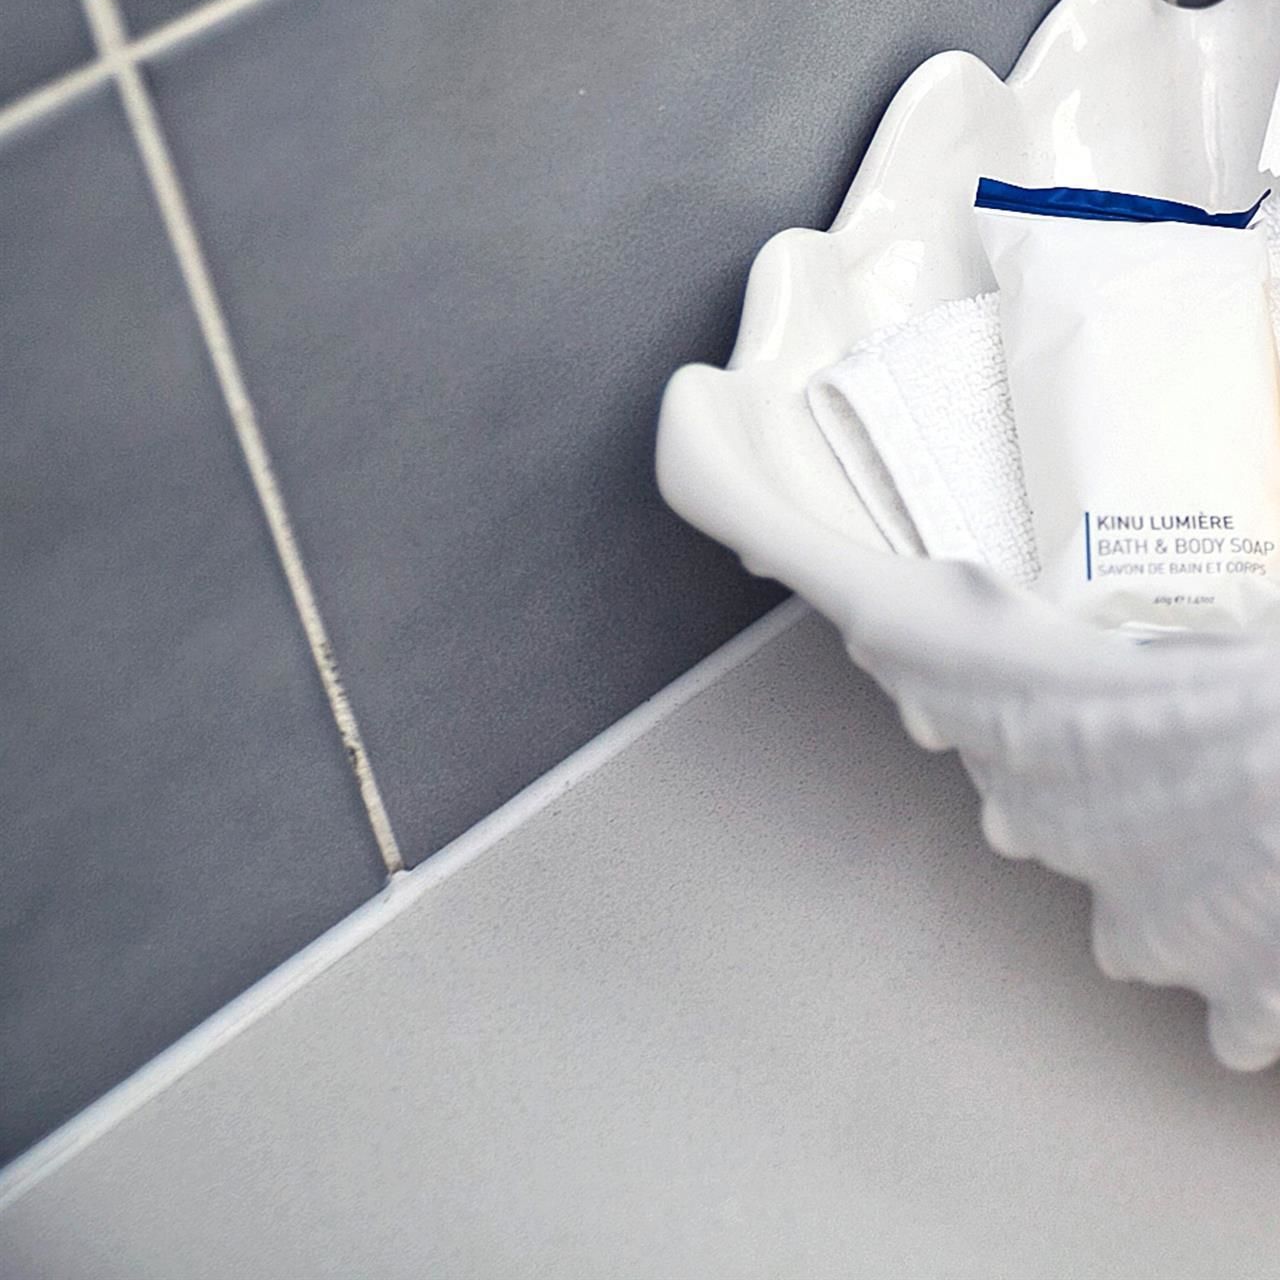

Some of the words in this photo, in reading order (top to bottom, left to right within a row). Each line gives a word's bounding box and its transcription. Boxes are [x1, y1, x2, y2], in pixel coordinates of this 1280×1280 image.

[1097, 515, 1144, 531] KINU
[1150, 511, 1235, 531] LUMIÈRE
[1098, 538, 1148, 556] BATH
[1154, 538, 1168, 555] &
[1175, 537, 1226, 555] BODY
[1230, 537, 1275, 556] SOAP
[1098, 562, 1144, 576] SAVON
[1148, 562, 1166, 575] DE
[1169, 562, 1203, 575] BAIN
[1206, 561, 1221, 574] ET
[1226, 560, 1268, 576] CORPS
